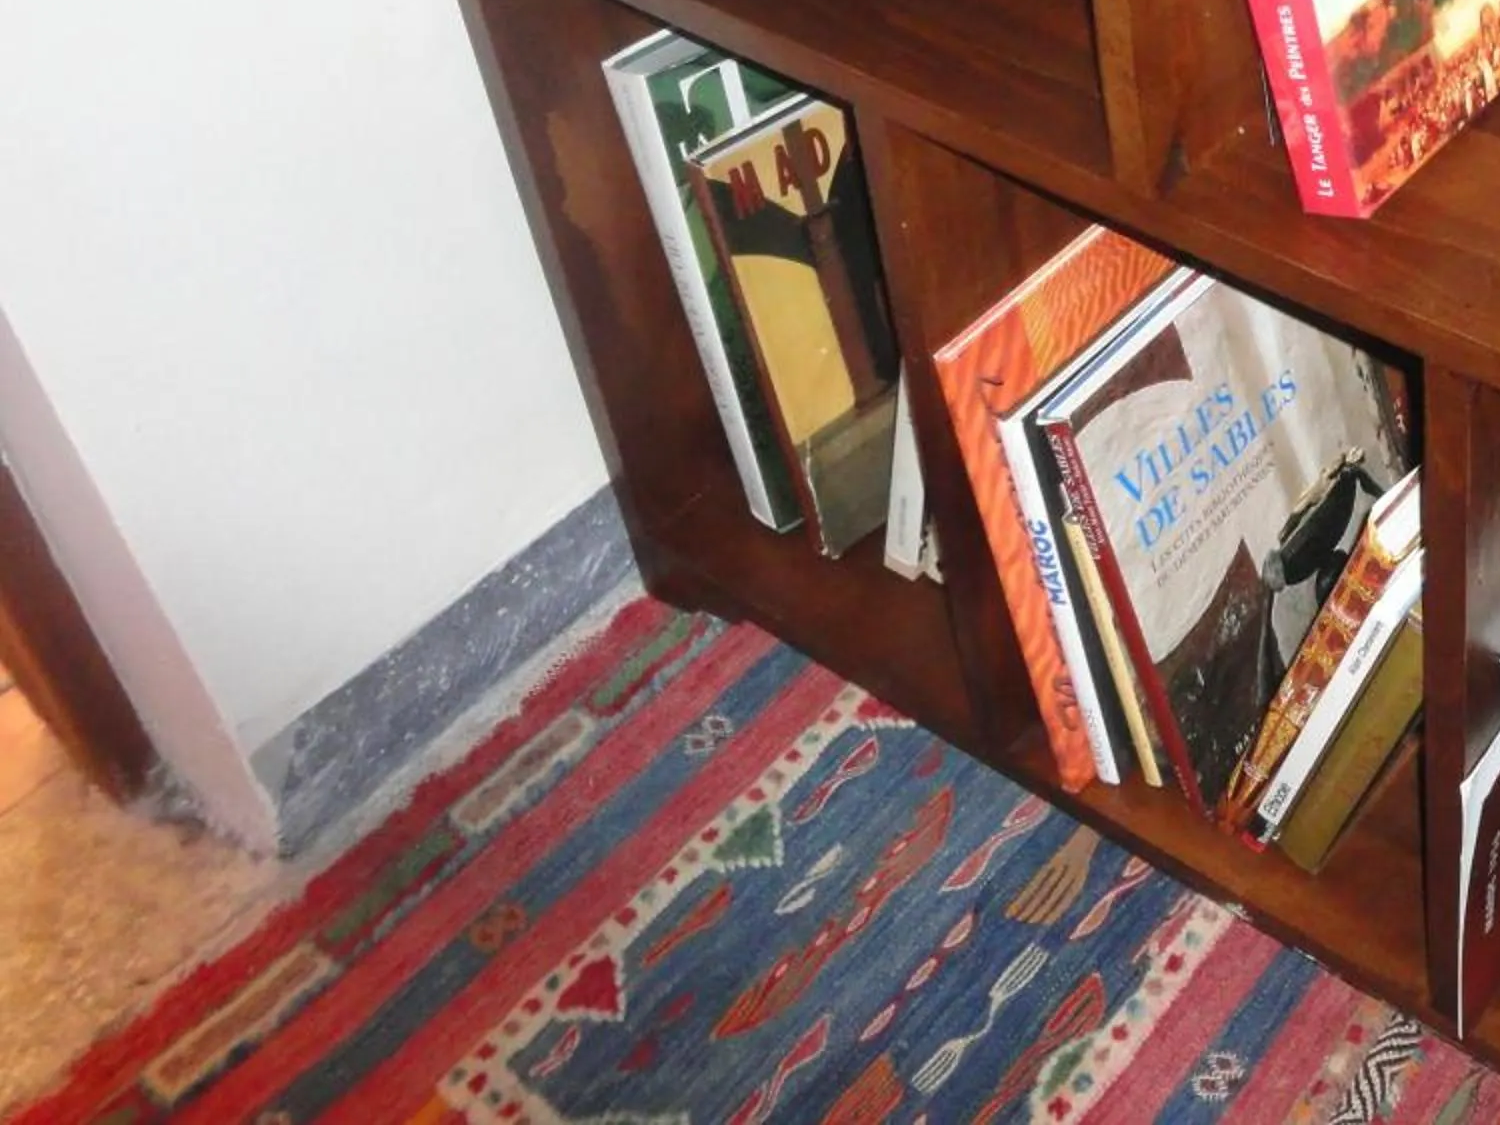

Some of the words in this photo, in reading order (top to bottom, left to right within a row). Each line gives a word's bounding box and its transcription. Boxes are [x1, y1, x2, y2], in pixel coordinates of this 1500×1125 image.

[1303, 113, 1328, 172] TANGER
[1115, 382, 1234, 502] VILLES
[1136, 485, 1187, 548] DE
[1190, 370, 1297, 495] SABLES
[1028, 519, 1067, 606] MAROC
